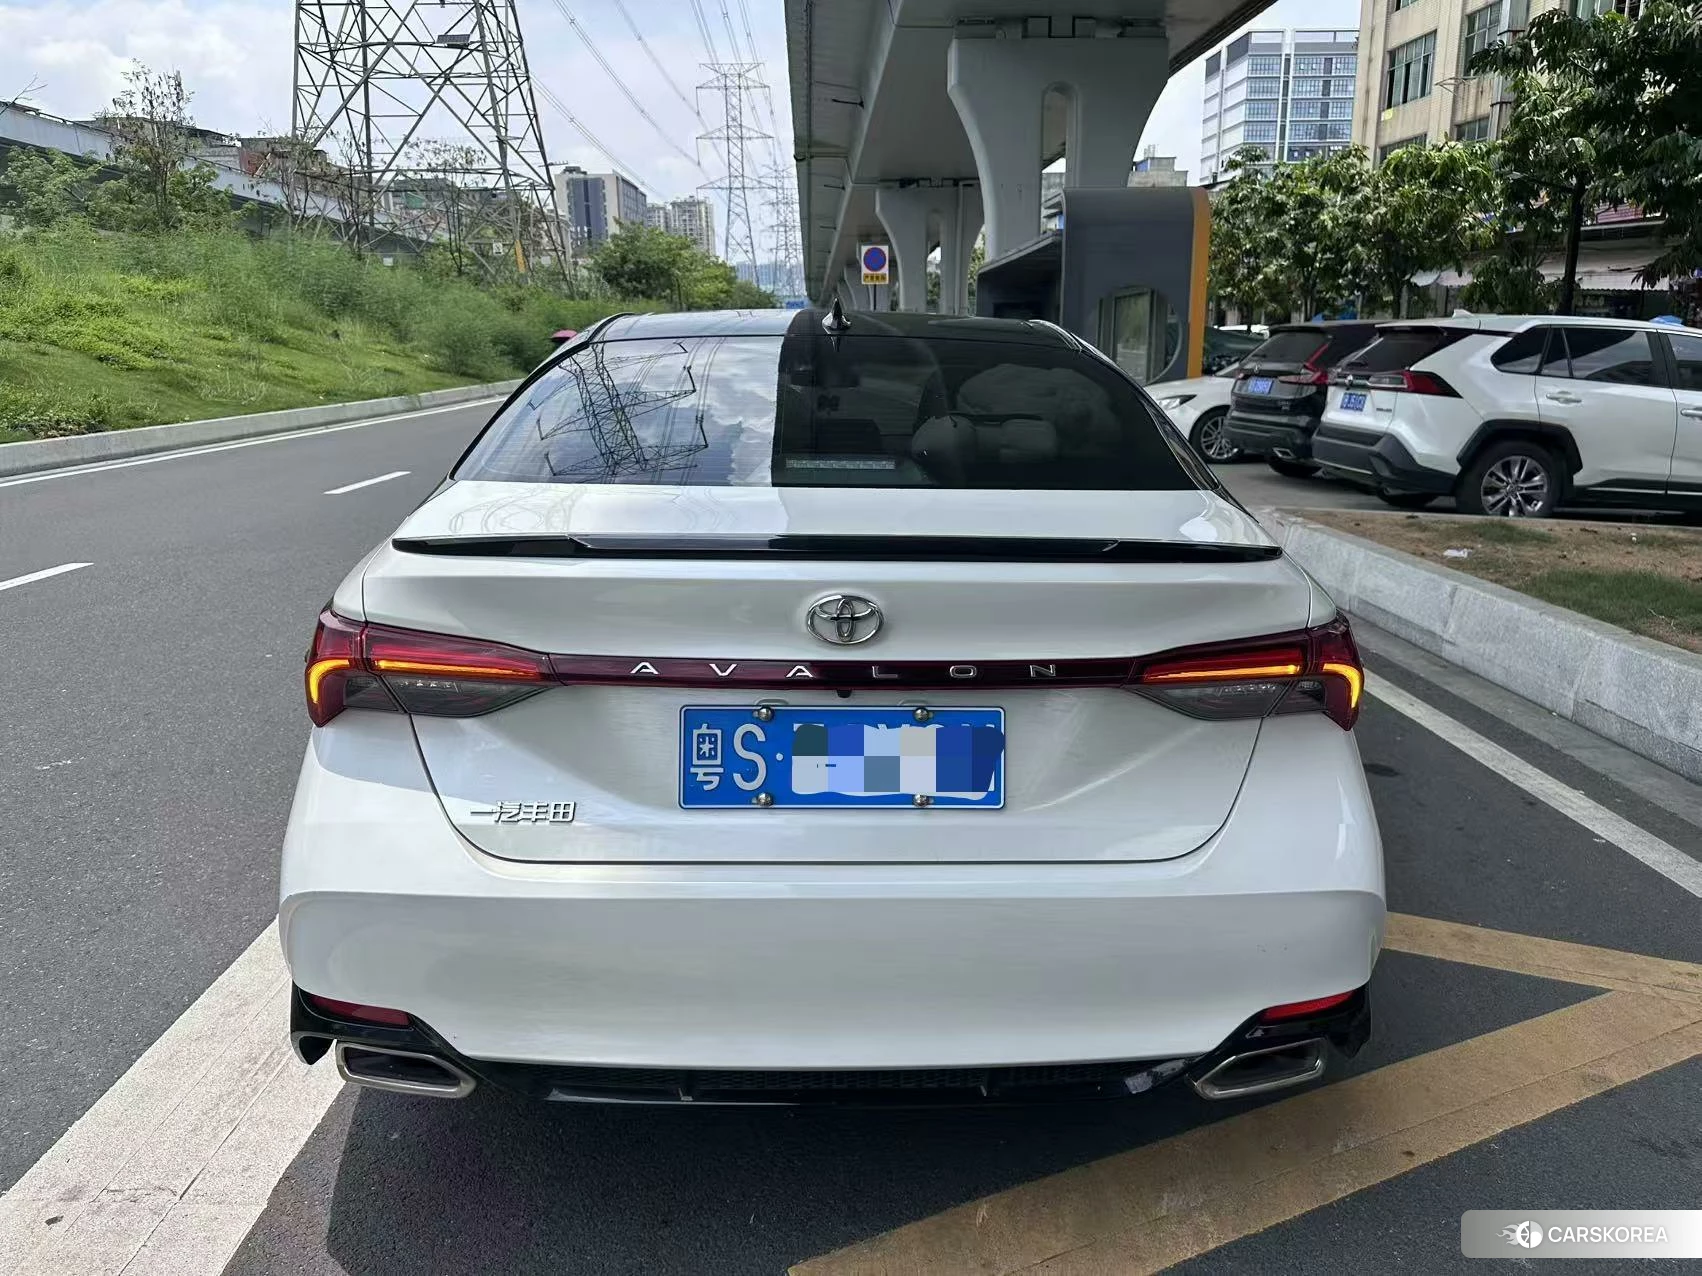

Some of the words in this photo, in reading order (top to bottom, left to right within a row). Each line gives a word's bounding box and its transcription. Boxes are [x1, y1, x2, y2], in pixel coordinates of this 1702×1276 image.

[630, 661, 1057, 680] AVALON
[470, 800, 577, 823] 一汽丰田
